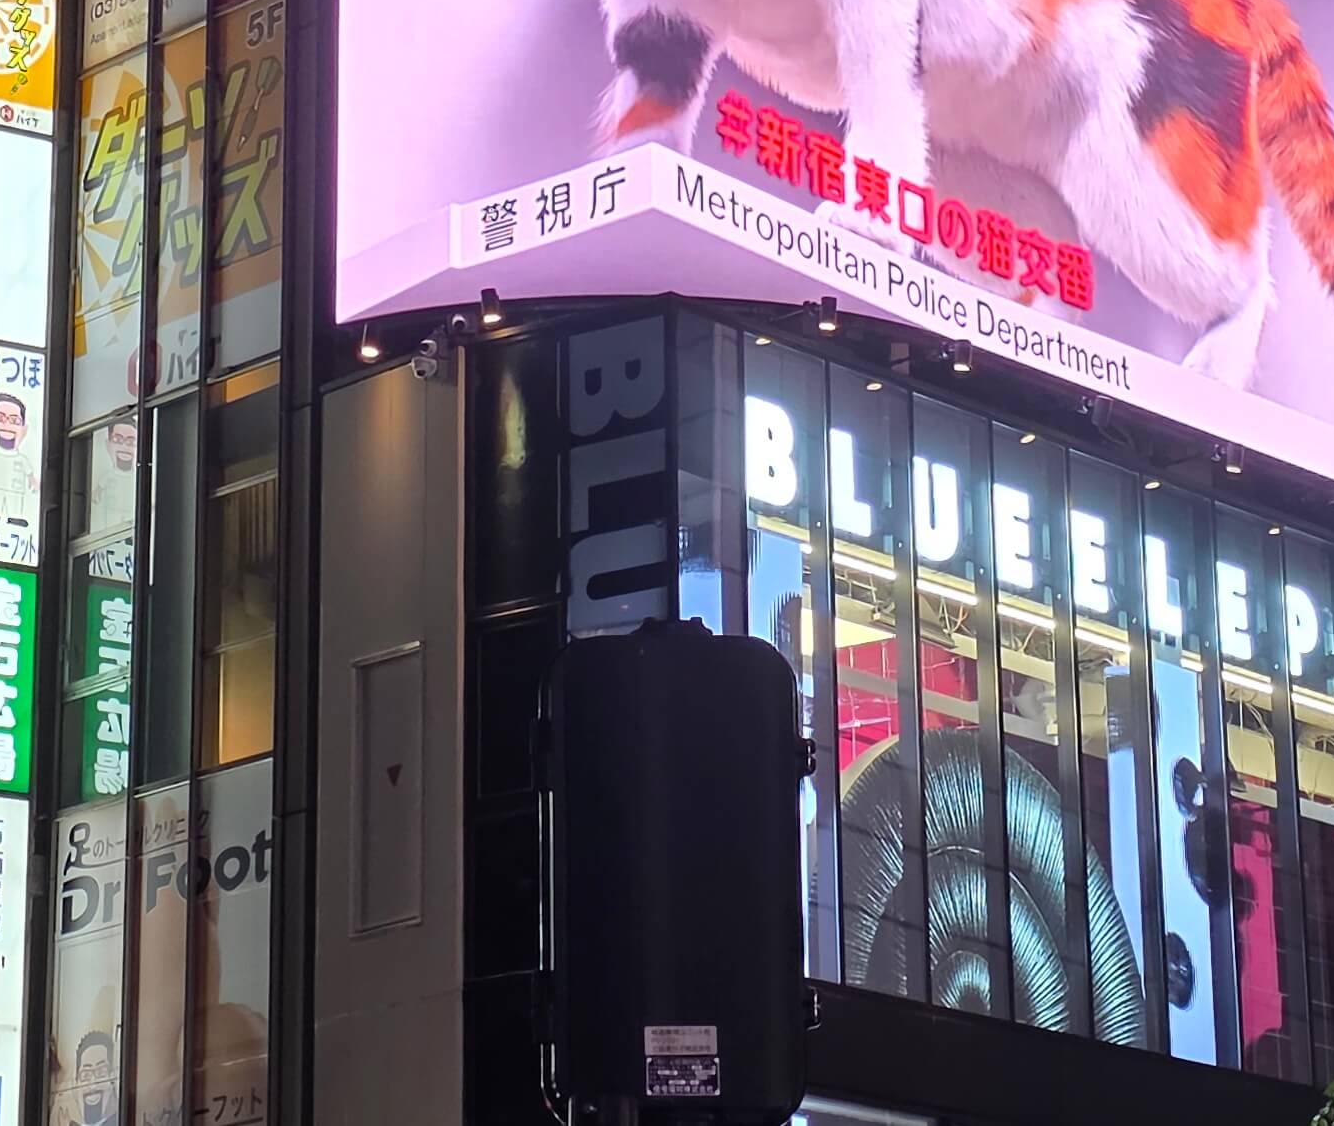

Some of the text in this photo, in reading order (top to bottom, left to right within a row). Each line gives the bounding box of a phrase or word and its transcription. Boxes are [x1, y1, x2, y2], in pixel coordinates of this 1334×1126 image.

[246, 1, 285, 49] 5F
[480, 165, 627, 253] 警視庁
[675, 165, 1132, 390] Metropolitan Police Department
[60, 829, 273, 935] Dr Foot
